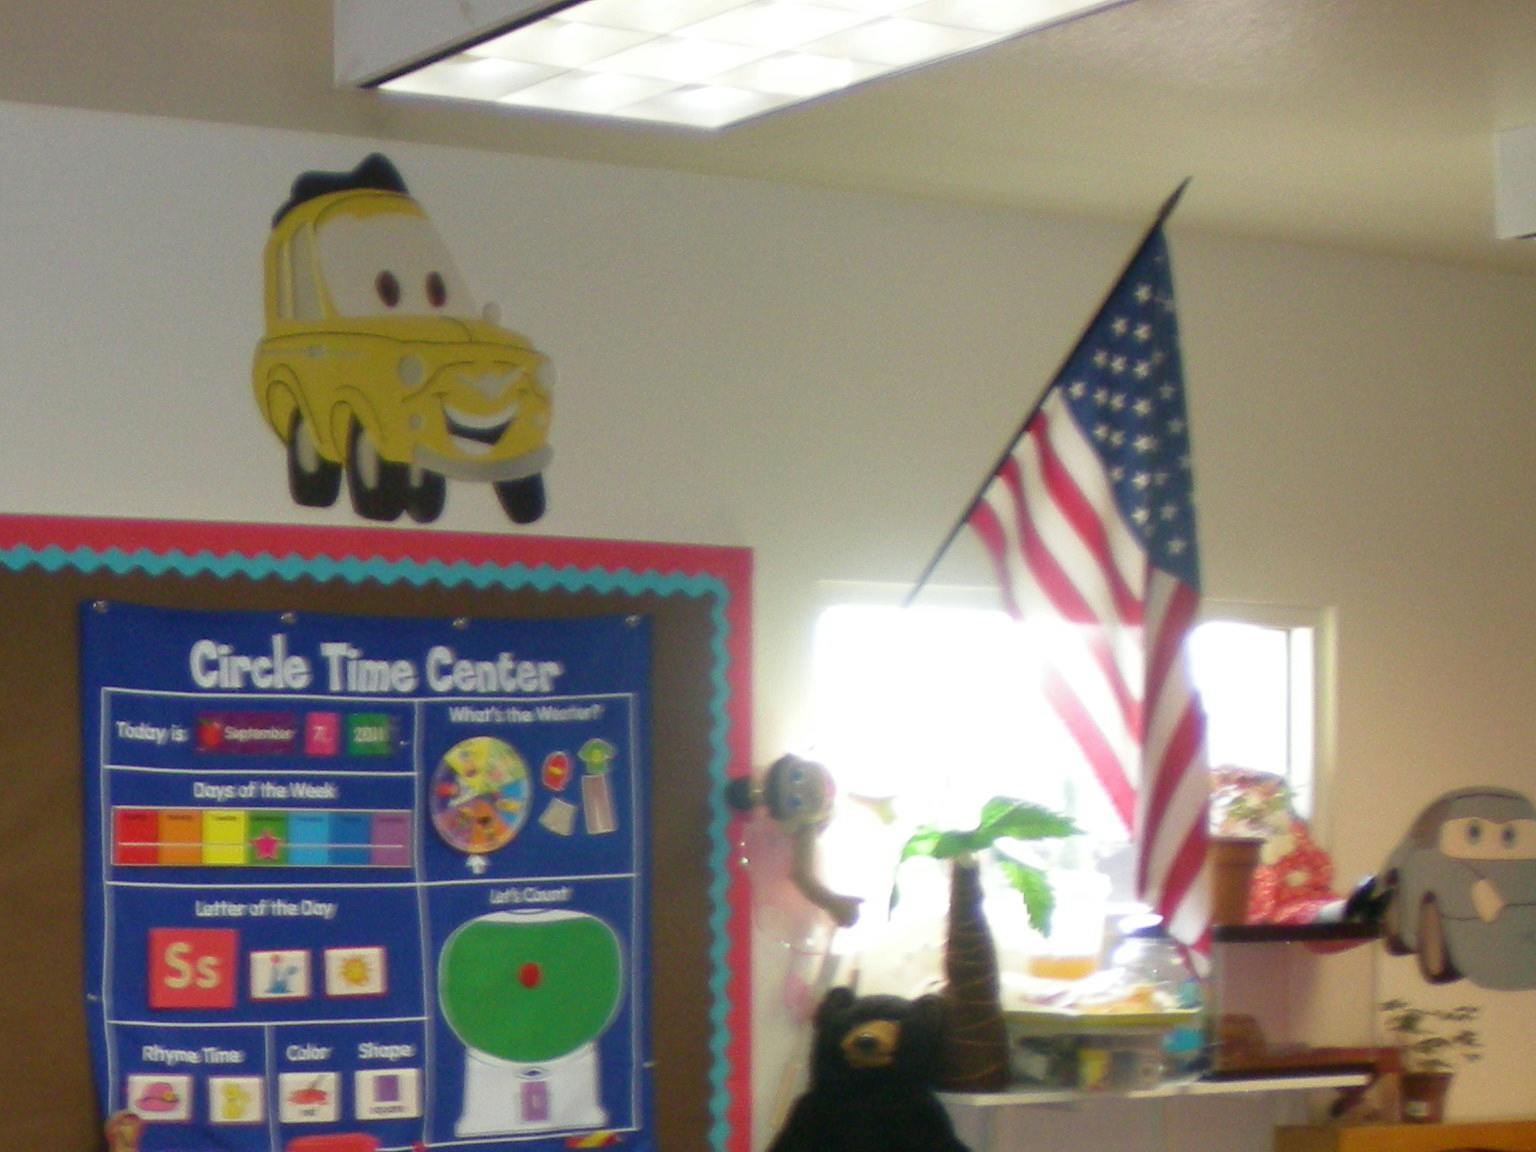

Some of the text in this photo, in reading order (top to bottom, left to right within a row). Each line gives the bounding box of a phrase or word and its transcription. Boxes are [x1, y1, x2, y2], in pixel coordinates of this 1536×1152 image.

[190, 635, 563, 694] Circle Time Center
[116, 721, 165, 745] Today
[193, 782, 338, 801] Days of the Week
[195, 899, 337, 920] Letter of the Day
[164, 941, 221, 989] Ss
[142, 1046, 245, 1066] Rhyme Time
[286, 1045, 331, 1061] Color
[358, 1042, 415, 1061] Shape
